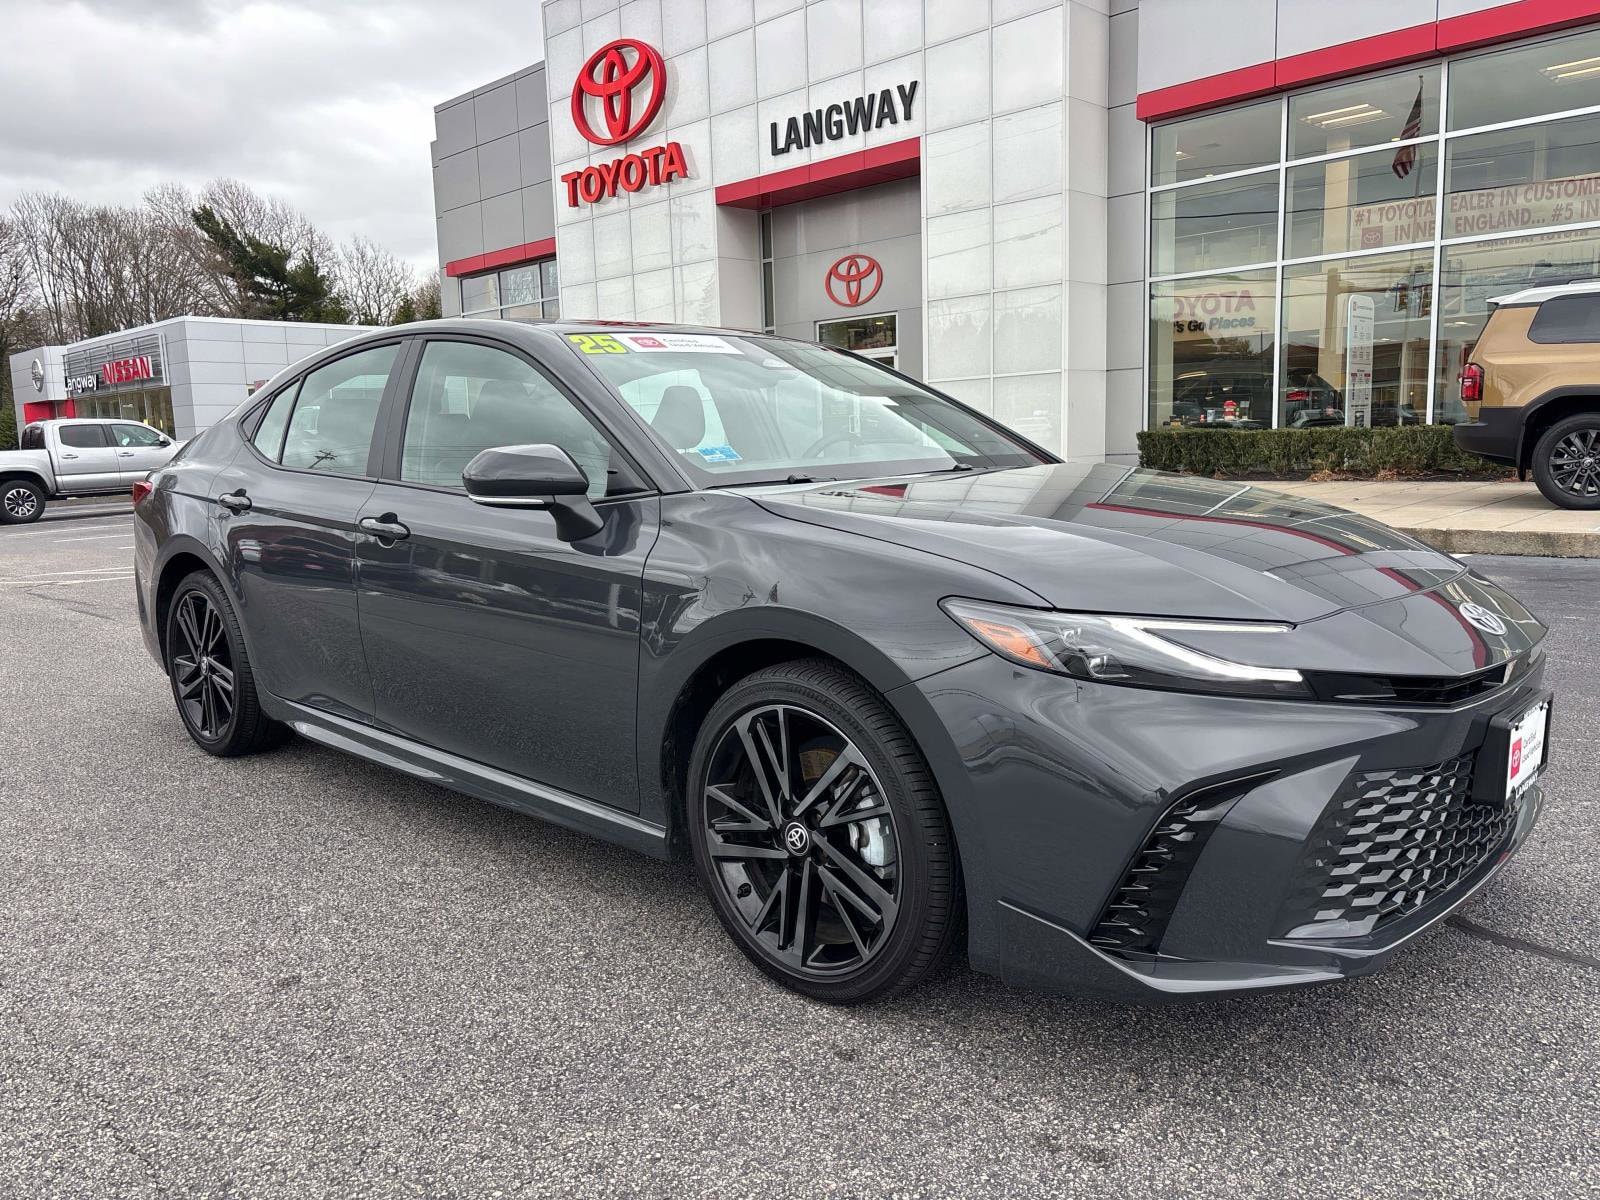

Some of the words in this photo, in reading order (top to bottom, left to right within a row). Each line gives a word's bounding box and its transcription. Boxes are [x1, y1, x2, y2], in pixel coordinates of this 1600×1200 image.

[770, 80, 920, 156] LANGWAY
[561, 141, 688, 207] TOYOTA
[1354, 209, 1372, 226] #1
[1378, 199, 1435, 222] TOYOTA
[1450, 191, 1495, 213] EALER
[1500, 188, 1518, 206] IN
[1523, 177, 1600, 202] CUSTOME
[1394, 224, 1409, 242] IN
[1415, 220, 1436, 240] NE
[1551, 201, 1574, 222] #5
[1174, 290, 1256, 318] OYOTA
[1187, 319, 1206, 332] Go
[1209, 317, 1256, 330] Places
[568, 335, 628, 354] 25
[65, 374, 98, 393] Langway
[102, 356, 154, 384] NISSAN
